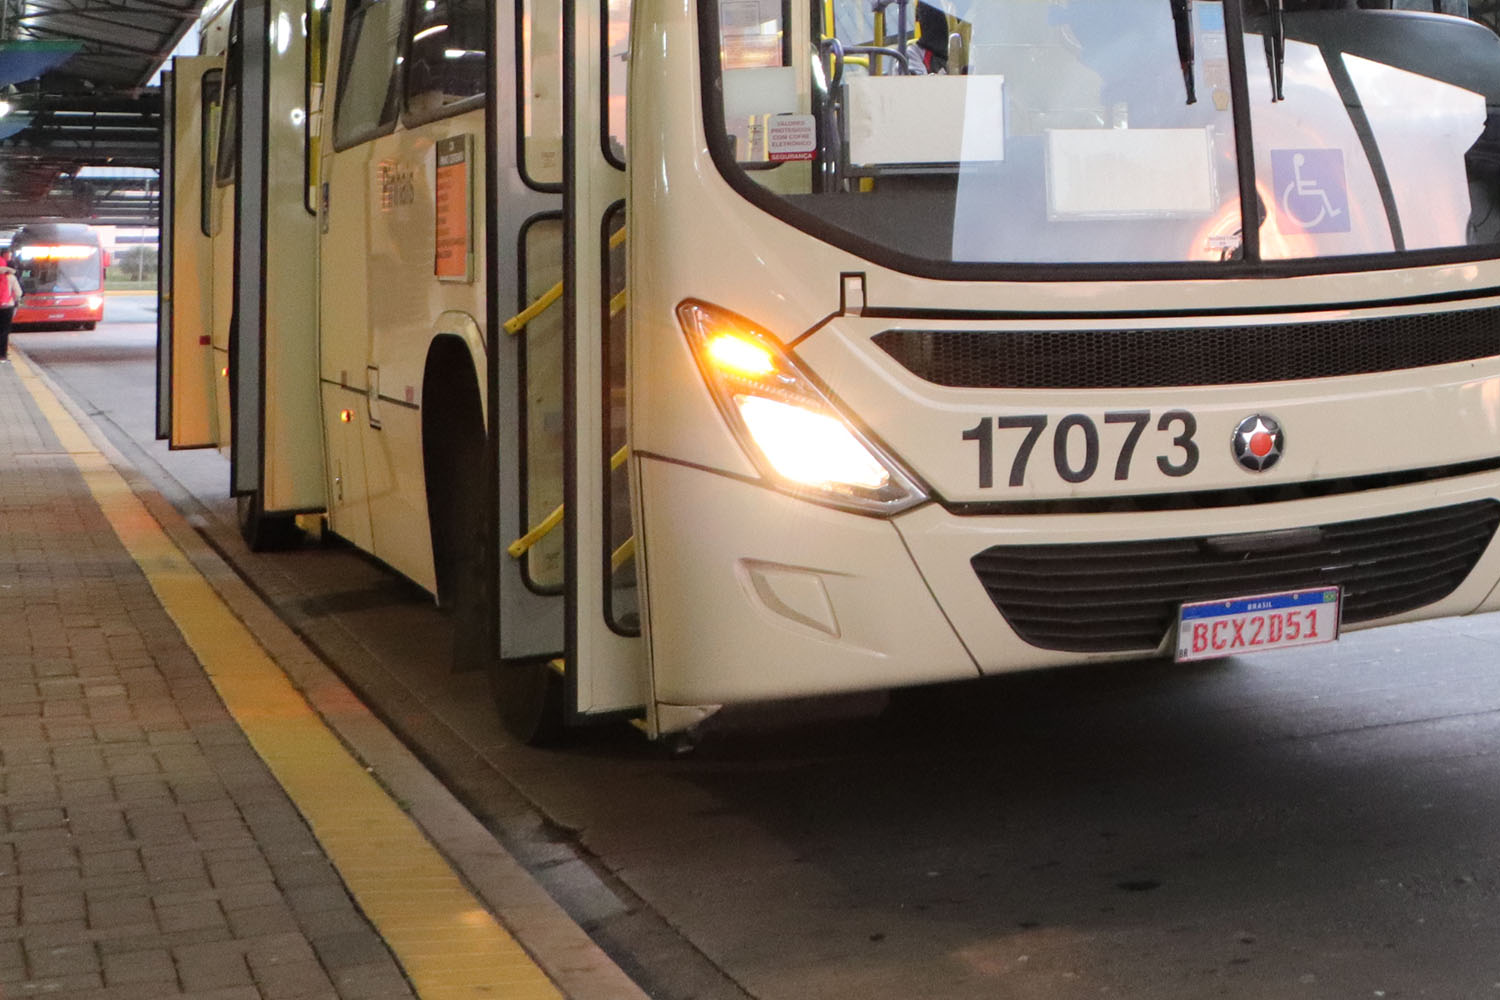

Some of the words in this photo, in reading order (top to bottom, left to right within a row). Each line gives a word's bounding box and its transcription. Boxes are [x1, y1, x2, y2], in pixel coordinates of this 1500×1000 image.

[771, 152, 813, 160] SEGURANÇA
[962, 408, 1200, 489] 17073
[1247, 601, 1273, 611] BRASIL
[1192, 609, 1318, 653] BCX2D51
